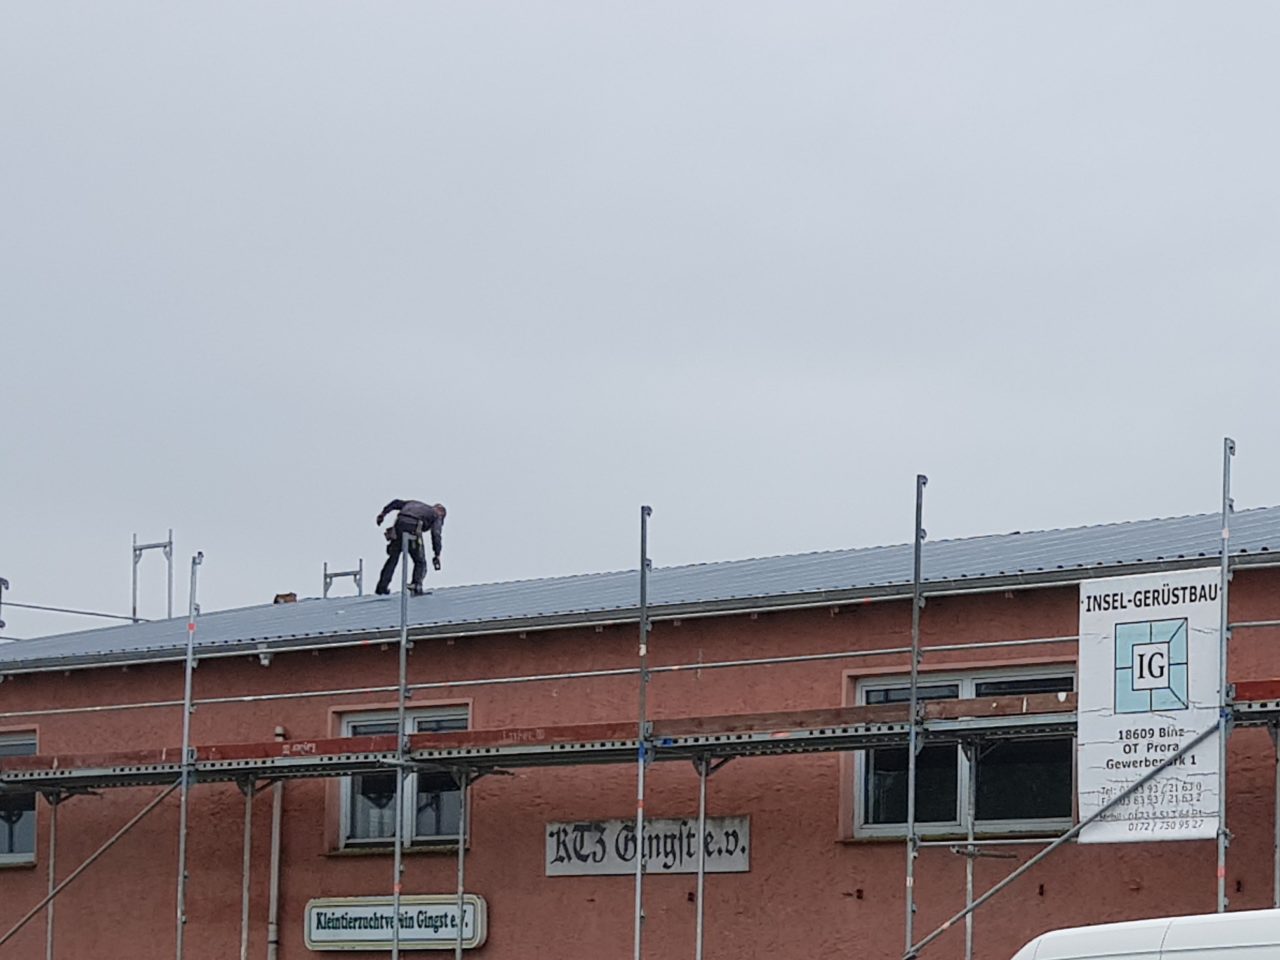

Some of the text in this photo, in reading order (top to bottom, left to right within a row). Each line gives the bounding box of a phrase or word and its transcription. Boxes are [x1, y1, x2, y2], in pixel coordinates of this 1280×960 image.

[1085, 583, 1219, 613] INSEL-GERÜSTBAU
[1136, 651, 1165, 680] IG
[1118, 726, 1185, 740] 18609 Binz
[1123, 742, 1179, 755] OT Prora
[1190, 754, 1197, 766] 1
[416, 910, 448, 934] Gingst
